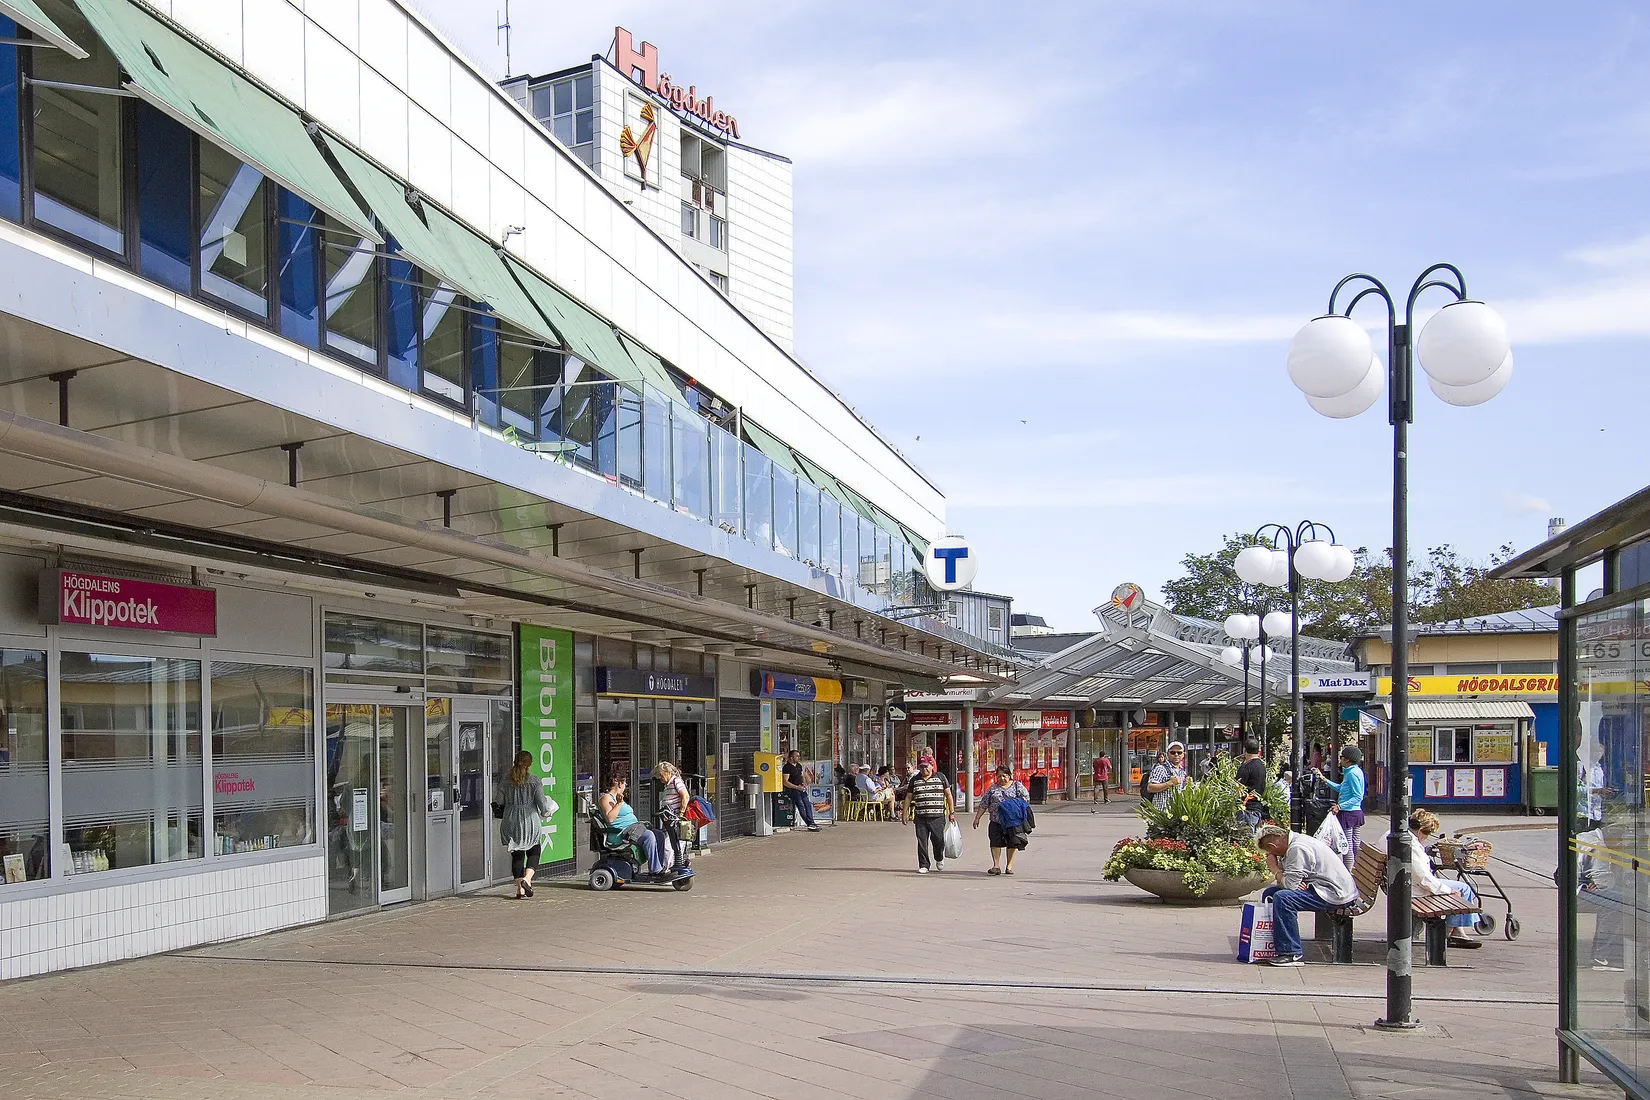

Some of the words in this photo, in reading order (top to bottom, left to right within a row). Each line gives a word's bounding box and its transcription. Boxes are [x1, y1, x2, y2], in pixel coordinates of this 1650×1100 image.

[615, 26, 740, 139] Högdalen
[934, 547, 968, 583] T
[64, 573, 120, 594] HÖGDALENS
[63, 588, 159, 626] Klippotek
[1582, 643, 1621, 659] 165
[1318, 678, 1341, 687] Mat
[1343, 678, 1367, 687] Dax
[539, 637, 557, 861] Bibliotk
[215, 777, 256, 796] Klippotek
